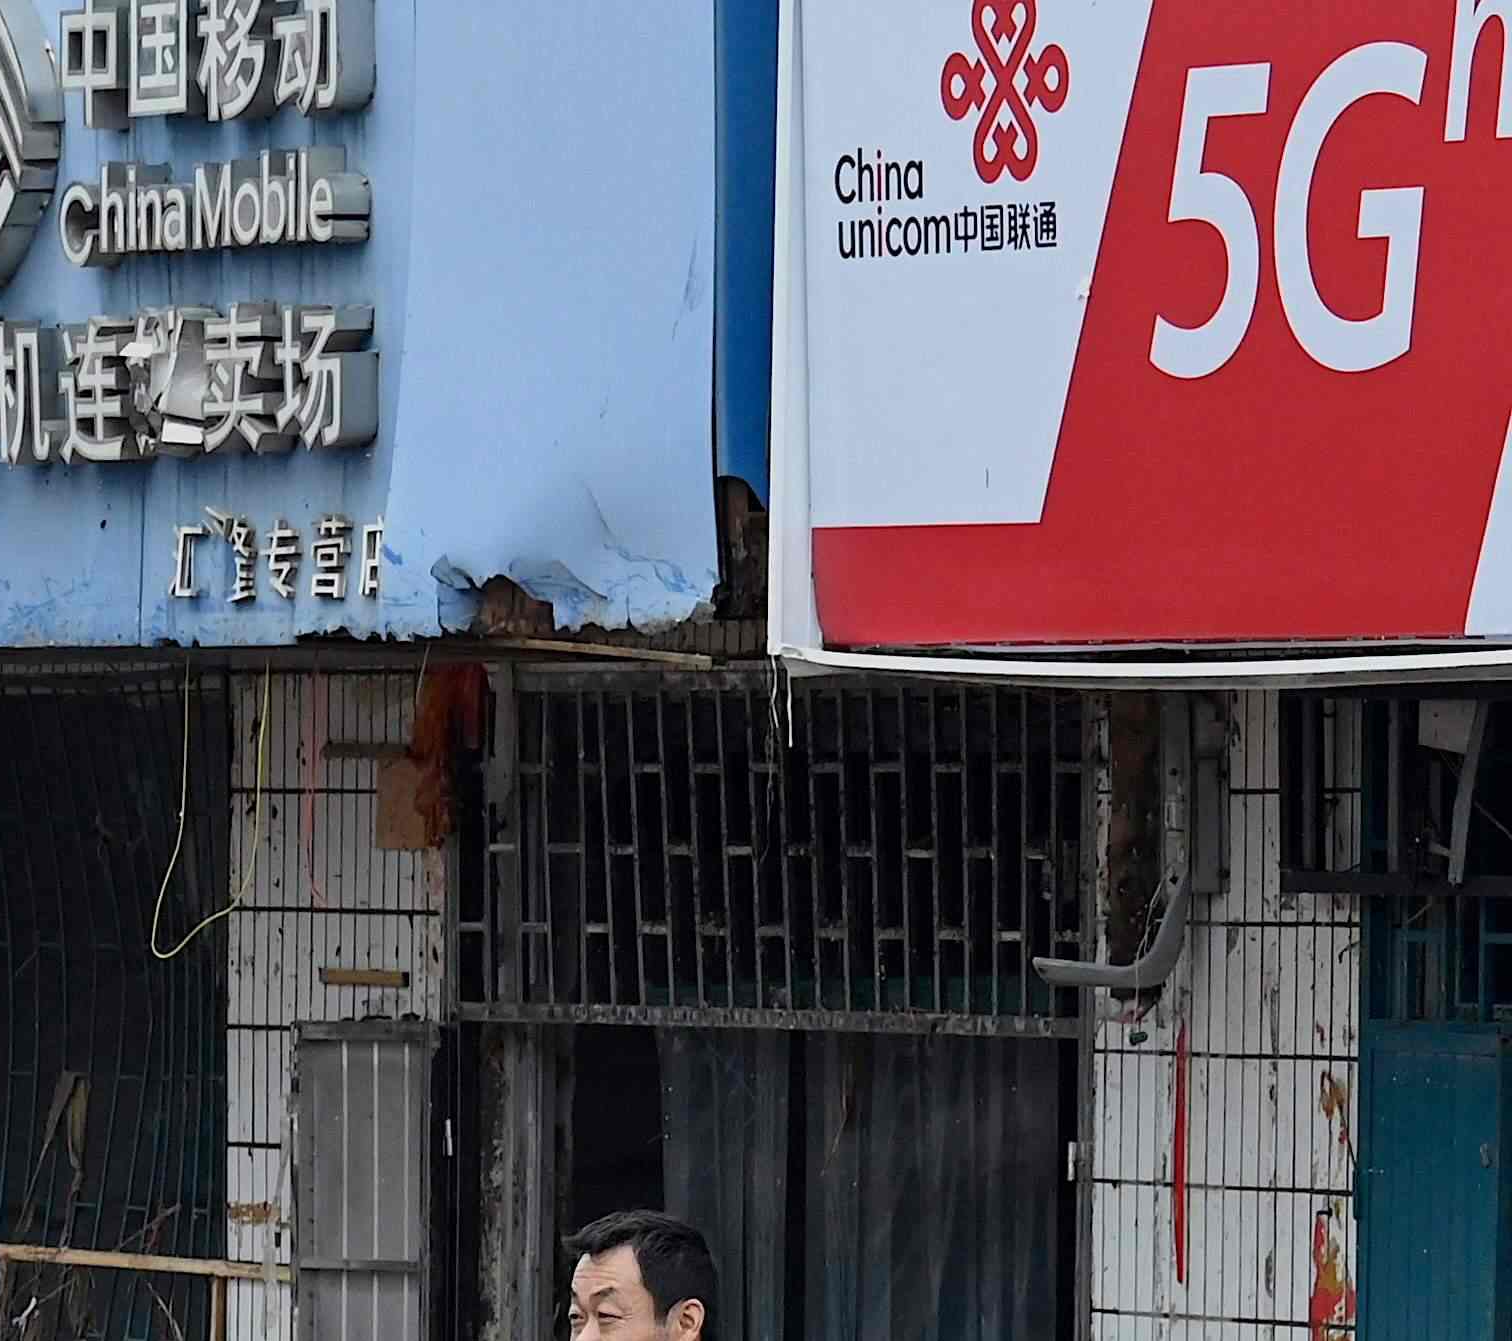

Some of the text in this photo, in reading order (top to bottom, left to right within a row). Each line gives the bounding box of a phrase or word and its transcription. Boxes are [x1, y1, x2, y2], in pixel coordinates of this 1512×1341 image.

[60, 0, 344, 124] 中国移动
[59, 150, 336, 267] China Mobile
[833, 147, 924, 202] China
[837, 201, 1059, 260] unicom 中国联通
